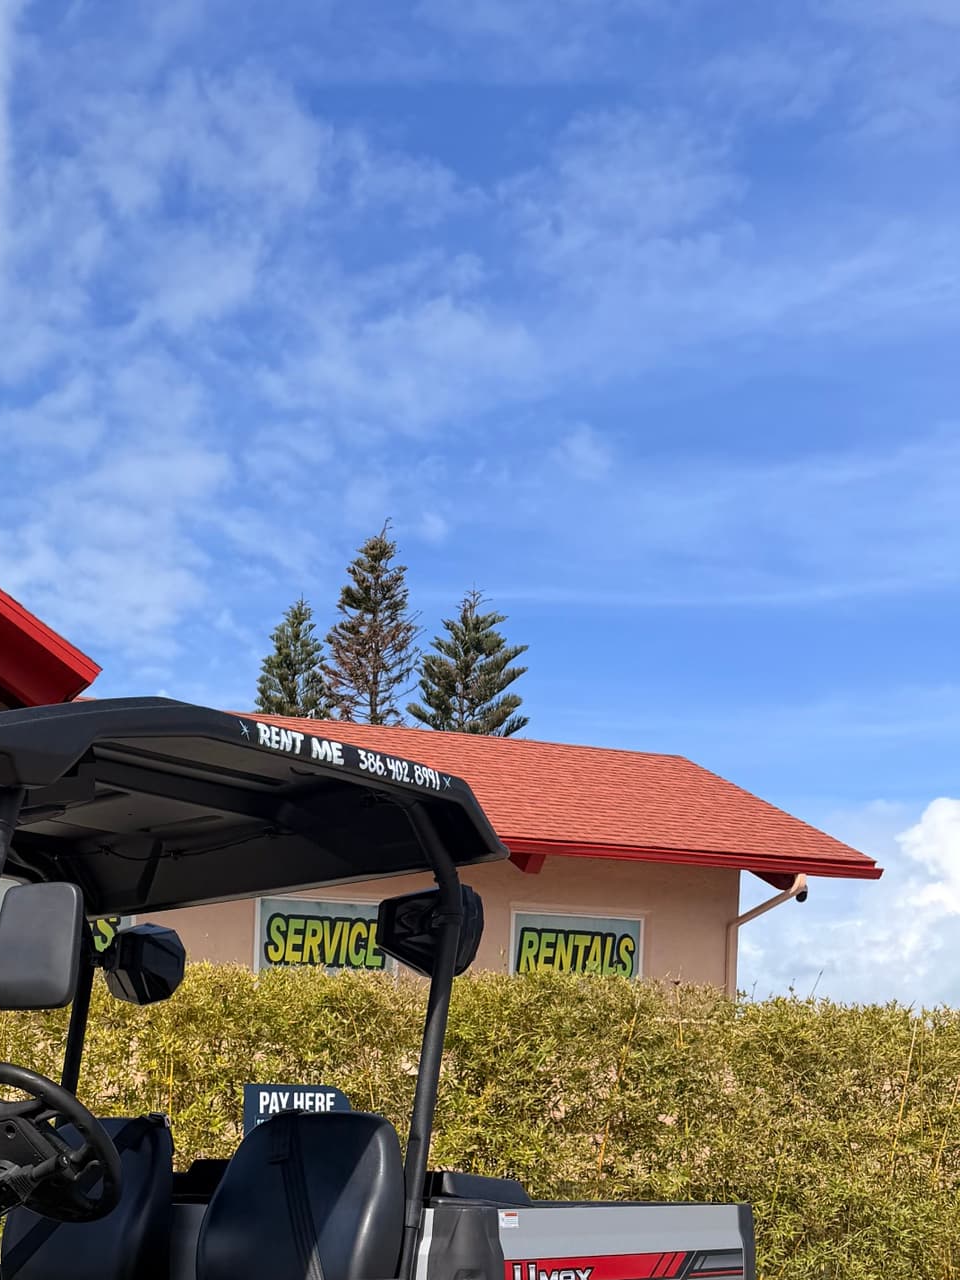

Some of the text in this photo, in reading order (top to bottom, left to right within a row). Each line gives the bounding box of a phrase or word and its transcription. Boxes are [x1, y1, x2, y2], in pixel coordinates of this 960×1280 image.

[256, 722, 440, 791] RENT ME 386.402.8991
[516, 928, 636, 979] RENTALS
[259, 1091, 290, 1114] PAY
